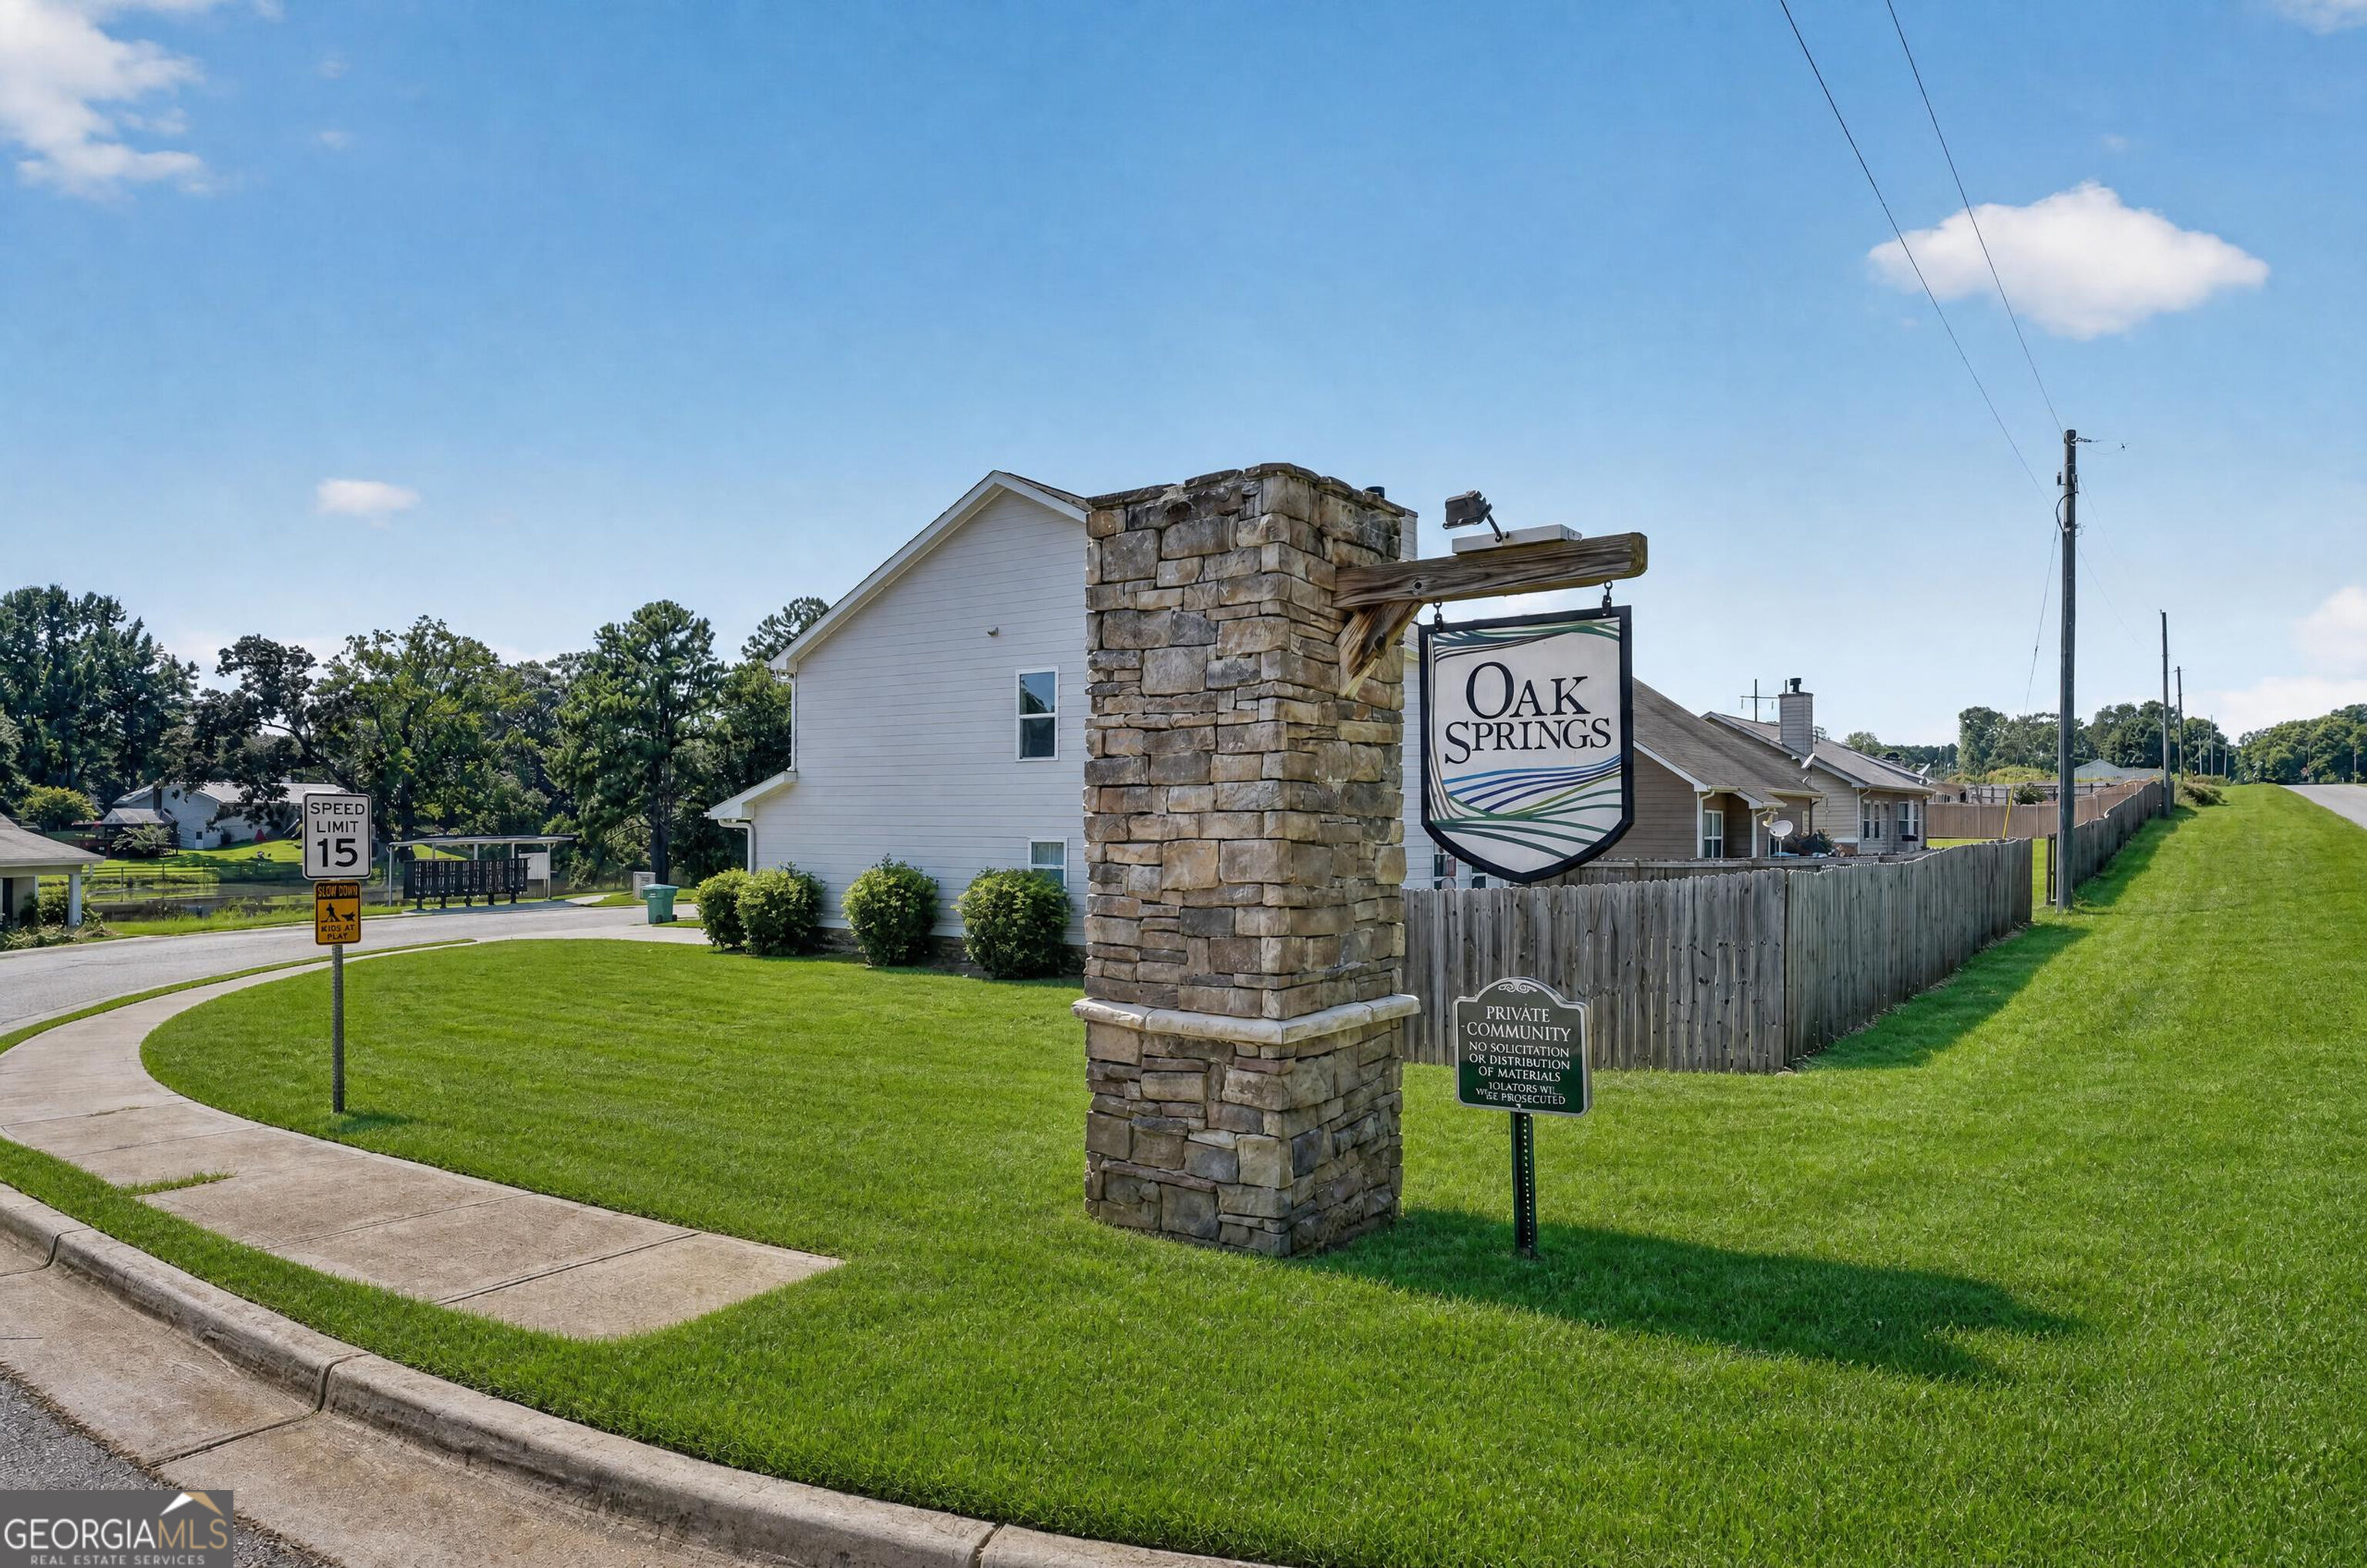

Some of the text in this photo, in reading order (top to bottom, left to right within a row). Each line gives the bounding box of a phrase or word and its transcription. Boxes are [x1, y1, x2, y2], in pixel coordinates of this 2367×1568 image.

[1466, 661, 1590, 719] OAK
[1444, 717, 1611, 764] SPRINGS
[311, 802, 365, 815] SPEED
[317, 821, 358, 833] LIMIT
[317, 838, 358, 868] 15
[317, 885, 358, 897] SLOW DOWN
[1486, 1006, 1550, 1022] PRIVATE
[1466, 1022, 1571, 1042] COMMUNITY
[1469, 1042, 1570, 1058] NO SOLICITATION
[1469, 1053, 1570, 1070] OR DISTRIBUTION
[1479, 1066, 1561, 1082] OF MATERIALS
[1501, 1093, 1566, 1105] PROSECUTED
